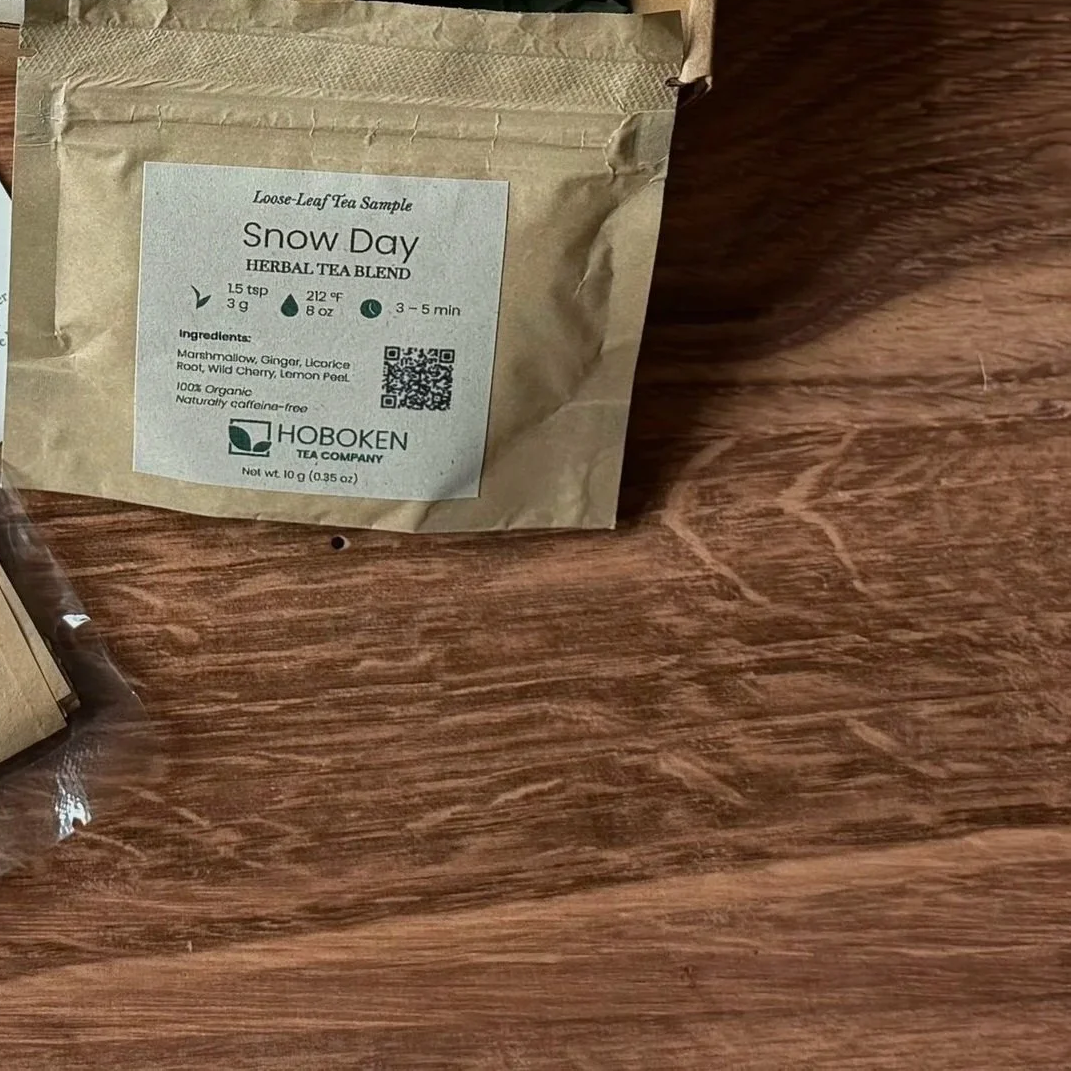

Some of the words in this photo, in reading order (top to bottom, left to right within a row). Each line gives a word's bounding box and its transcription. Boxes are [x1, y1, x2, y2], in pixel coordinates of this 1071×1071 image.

[252, 189, 332, 212] Loose-Leaf
[331, 193, 357, 210] Tea
[359, 195, 413, 215] Sample
[242, 221, 340, 252] Snow
[349, 227, 420, 265] Day
[246, 258, 314, 275] HERBAL
[316, 262, 351, 278] TEA
[353, 264, 412, 280] BLEND
[246, 284, 269, 299] tsp
[305, 290, 327, 303] 212
[317, 307, 334, 318] oz
[433, 304, 461, 317] min
[179, 328, 252, 343] Ingredients:
[177, 348, 258, 365] Marshmallow,
[260, 354, 303, 369] Ginger,
[304, 357, 351, 371] Licorice
[176, 360, 206, 374] Root,
[207, 364, 233, 375] Wild
[235, 366, 277, 380] Cherry,
[279, 368, 321, 381] Lemon
[176, 381, 202, 396] 100%
[204, 384, 253, 398] Organic
[175, 394, 229, 410] Naturally
[229, 399, 309, 414] caffeine-free
[278, 423, 408, 451] HOBOKEN
[296, 448, 319, 460] TEA
[320, 451, 384, 464] COMPANY
[241, 466, 261, 478] Net
[283, 469, 295, 480] 10
[308, 469, 338, 483] (0.35
[339, 472, 359, 486] oz)
